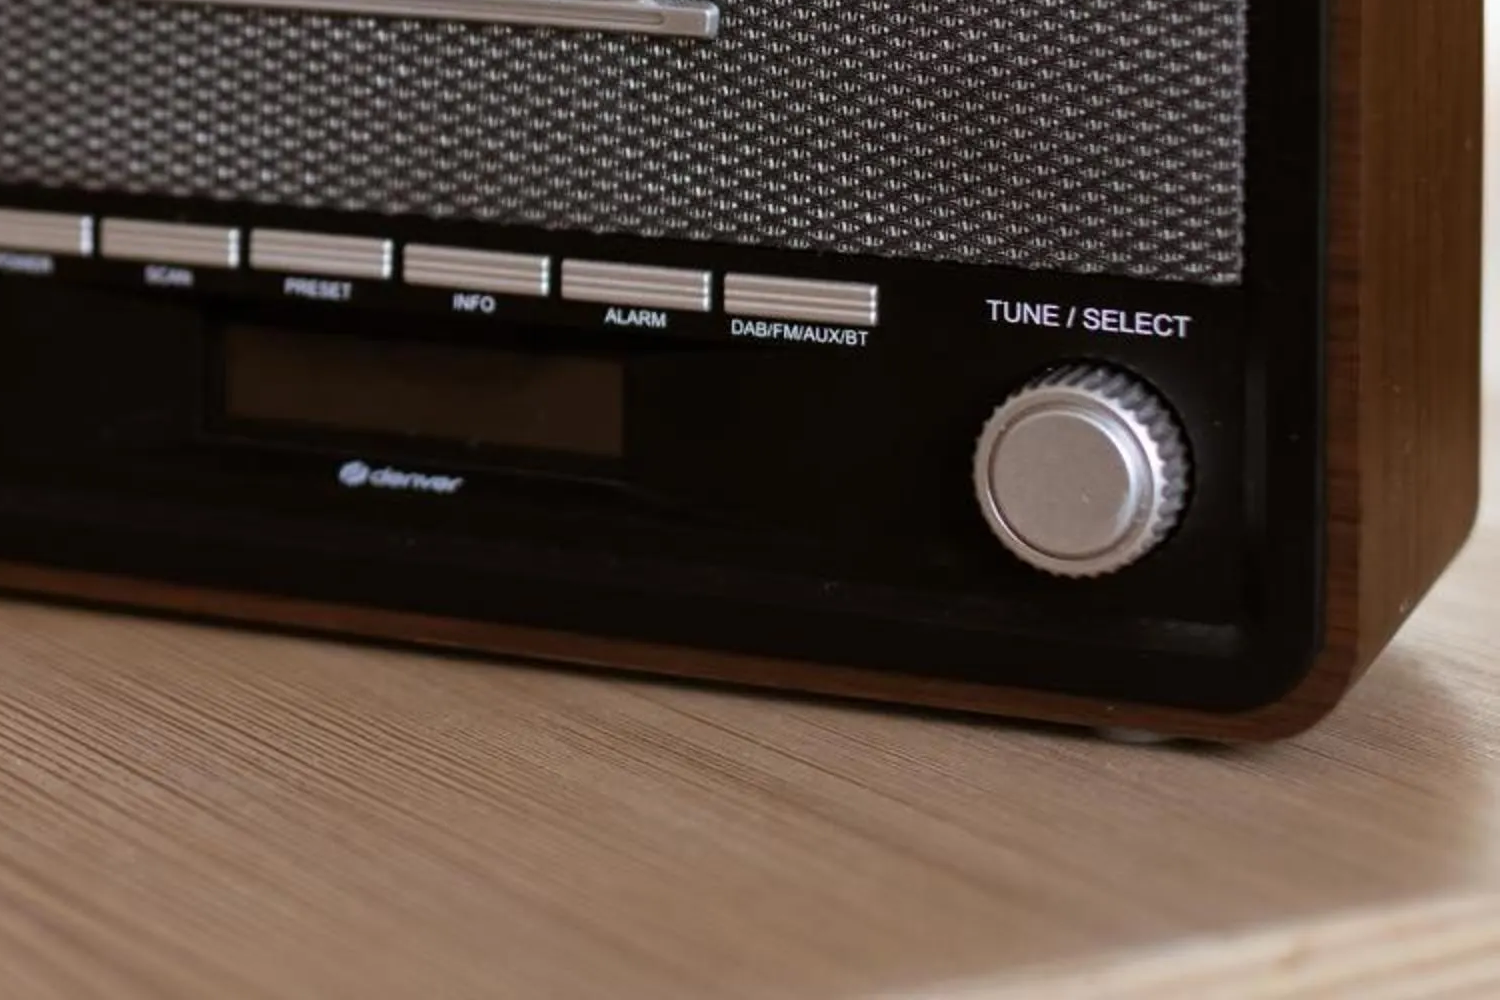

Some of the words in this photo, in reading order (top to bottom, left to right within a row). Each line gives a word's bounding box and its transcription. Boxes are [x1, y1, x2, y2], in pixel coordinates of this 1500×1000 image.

[145, 265, 193, 286] SCAN
[284, 276, 353, 299] PRESET
[453, 293, 496, 313] INFO
[605, 307, 667, 328] ALARM
[986, 299, 1060, 327] TUNE
[1083, 308, 1191, 337] SELECT
[731, 318, 869, 346] DAB/FM/AUX/BT
[369, 467, 464, 492] denver
